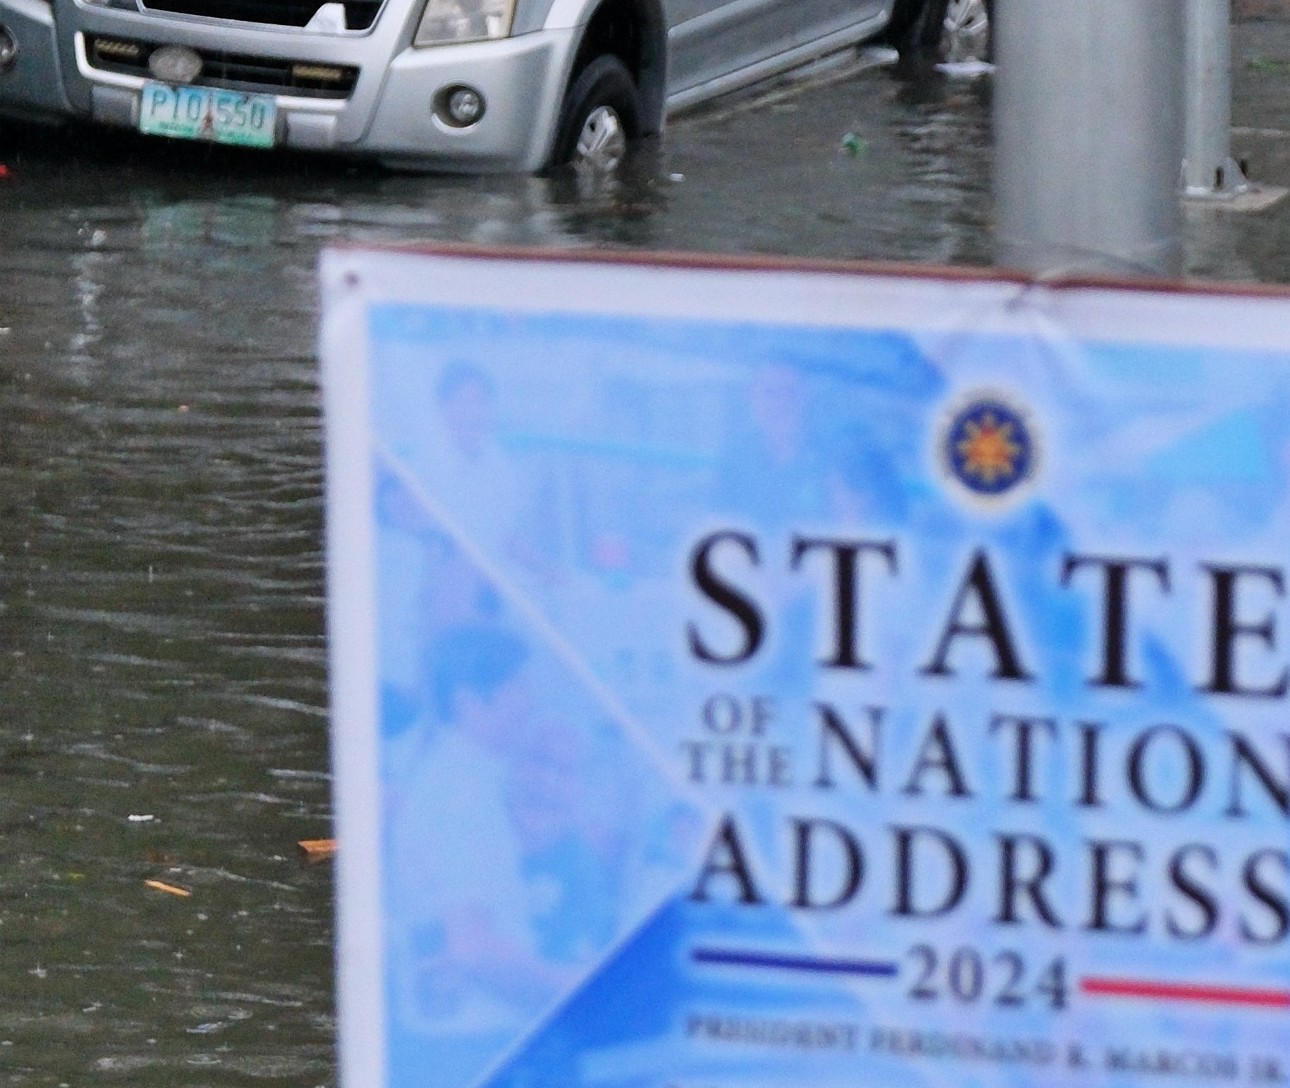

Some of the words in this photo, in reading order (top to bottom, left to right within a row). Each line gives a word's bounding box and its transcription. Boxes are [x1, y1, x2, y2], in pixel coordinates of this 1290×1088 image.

[700, 692, 782, 737] OF
[681, 739, 793, 788] THE
[907, 942, 1067, 1012] 2024
[686, 1013, 858, 1050] PRESIDENT
[870, 1025, 1056, 1065] FERDINAND
[1104, 1047, 1239, 1079] MARCOS
